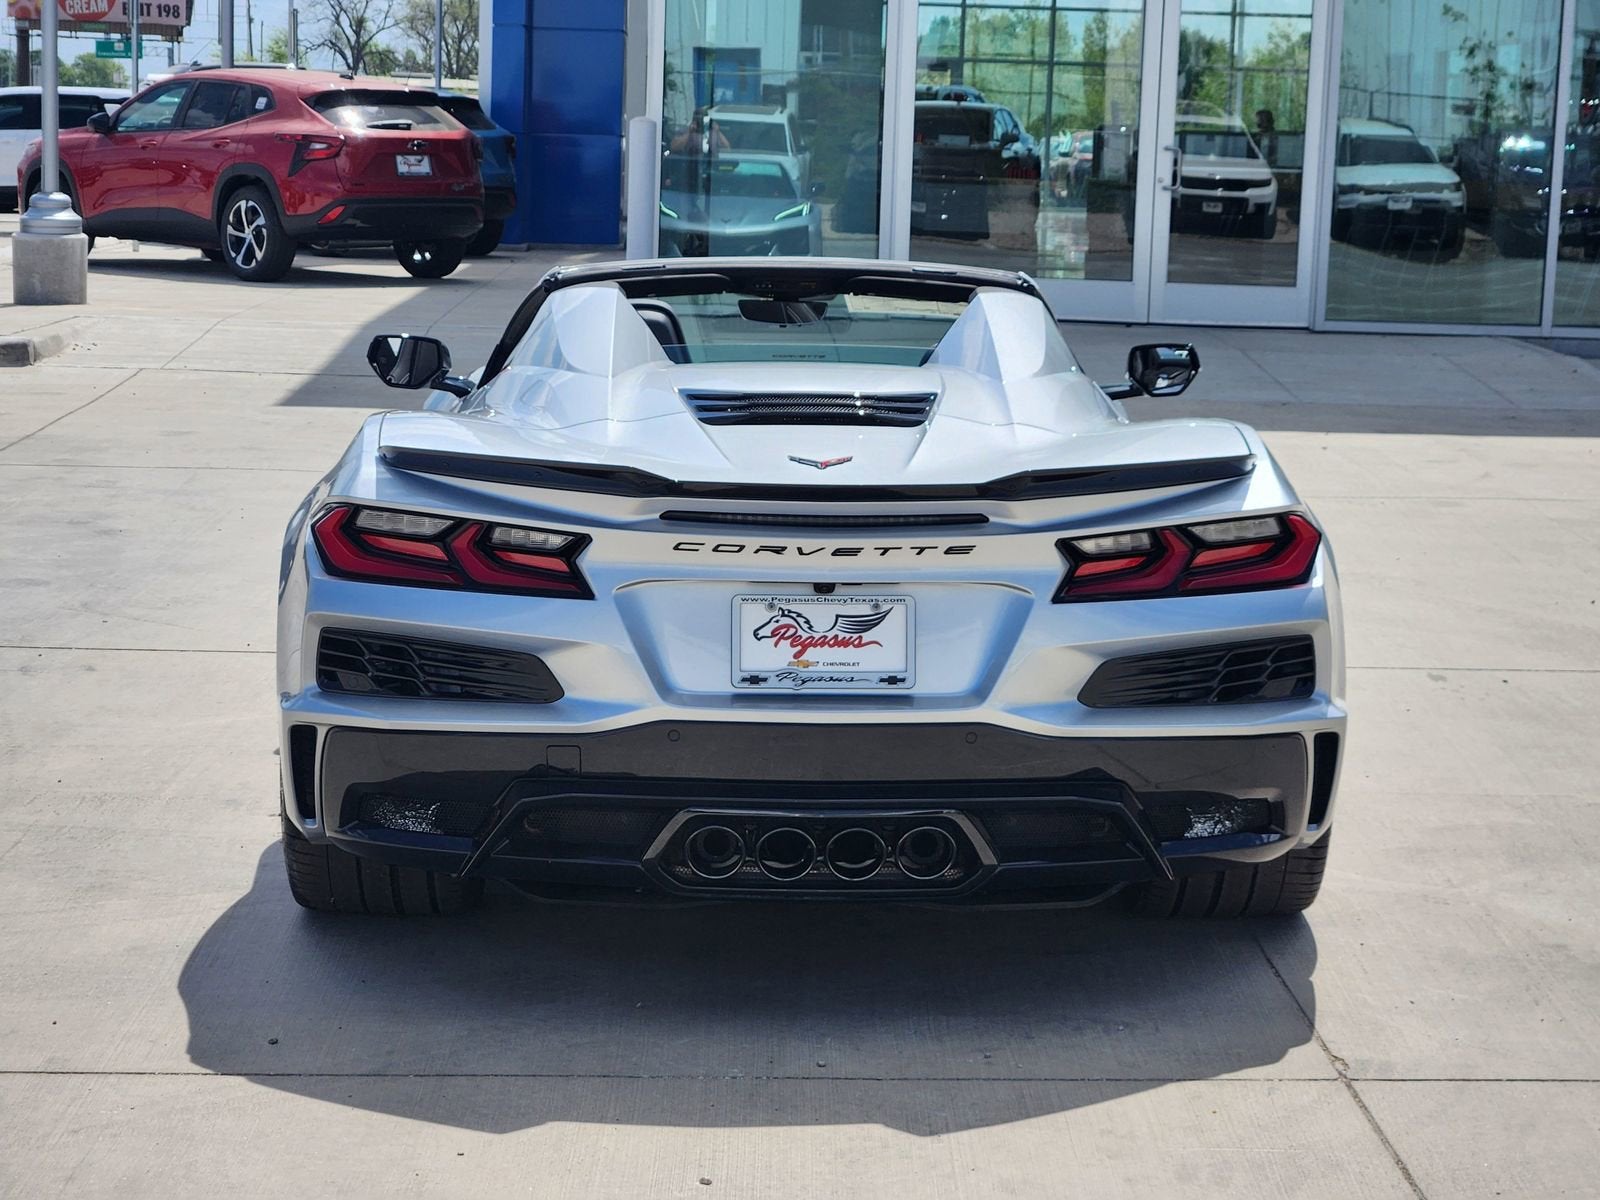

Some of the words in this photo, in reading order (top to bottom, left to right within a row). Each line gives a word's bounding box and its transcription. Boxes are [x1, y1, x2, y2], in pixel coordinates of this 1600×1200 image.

[65, 0, 109, 14] CREAM
[122, 2, 152, 17] EIT
[156, 4, 180, 19] 198
[672, 541, 978, 557] CORVETTE
[770, 623, 883, 660] Pegasus
[775, 671, 874, 687] Pegasus
